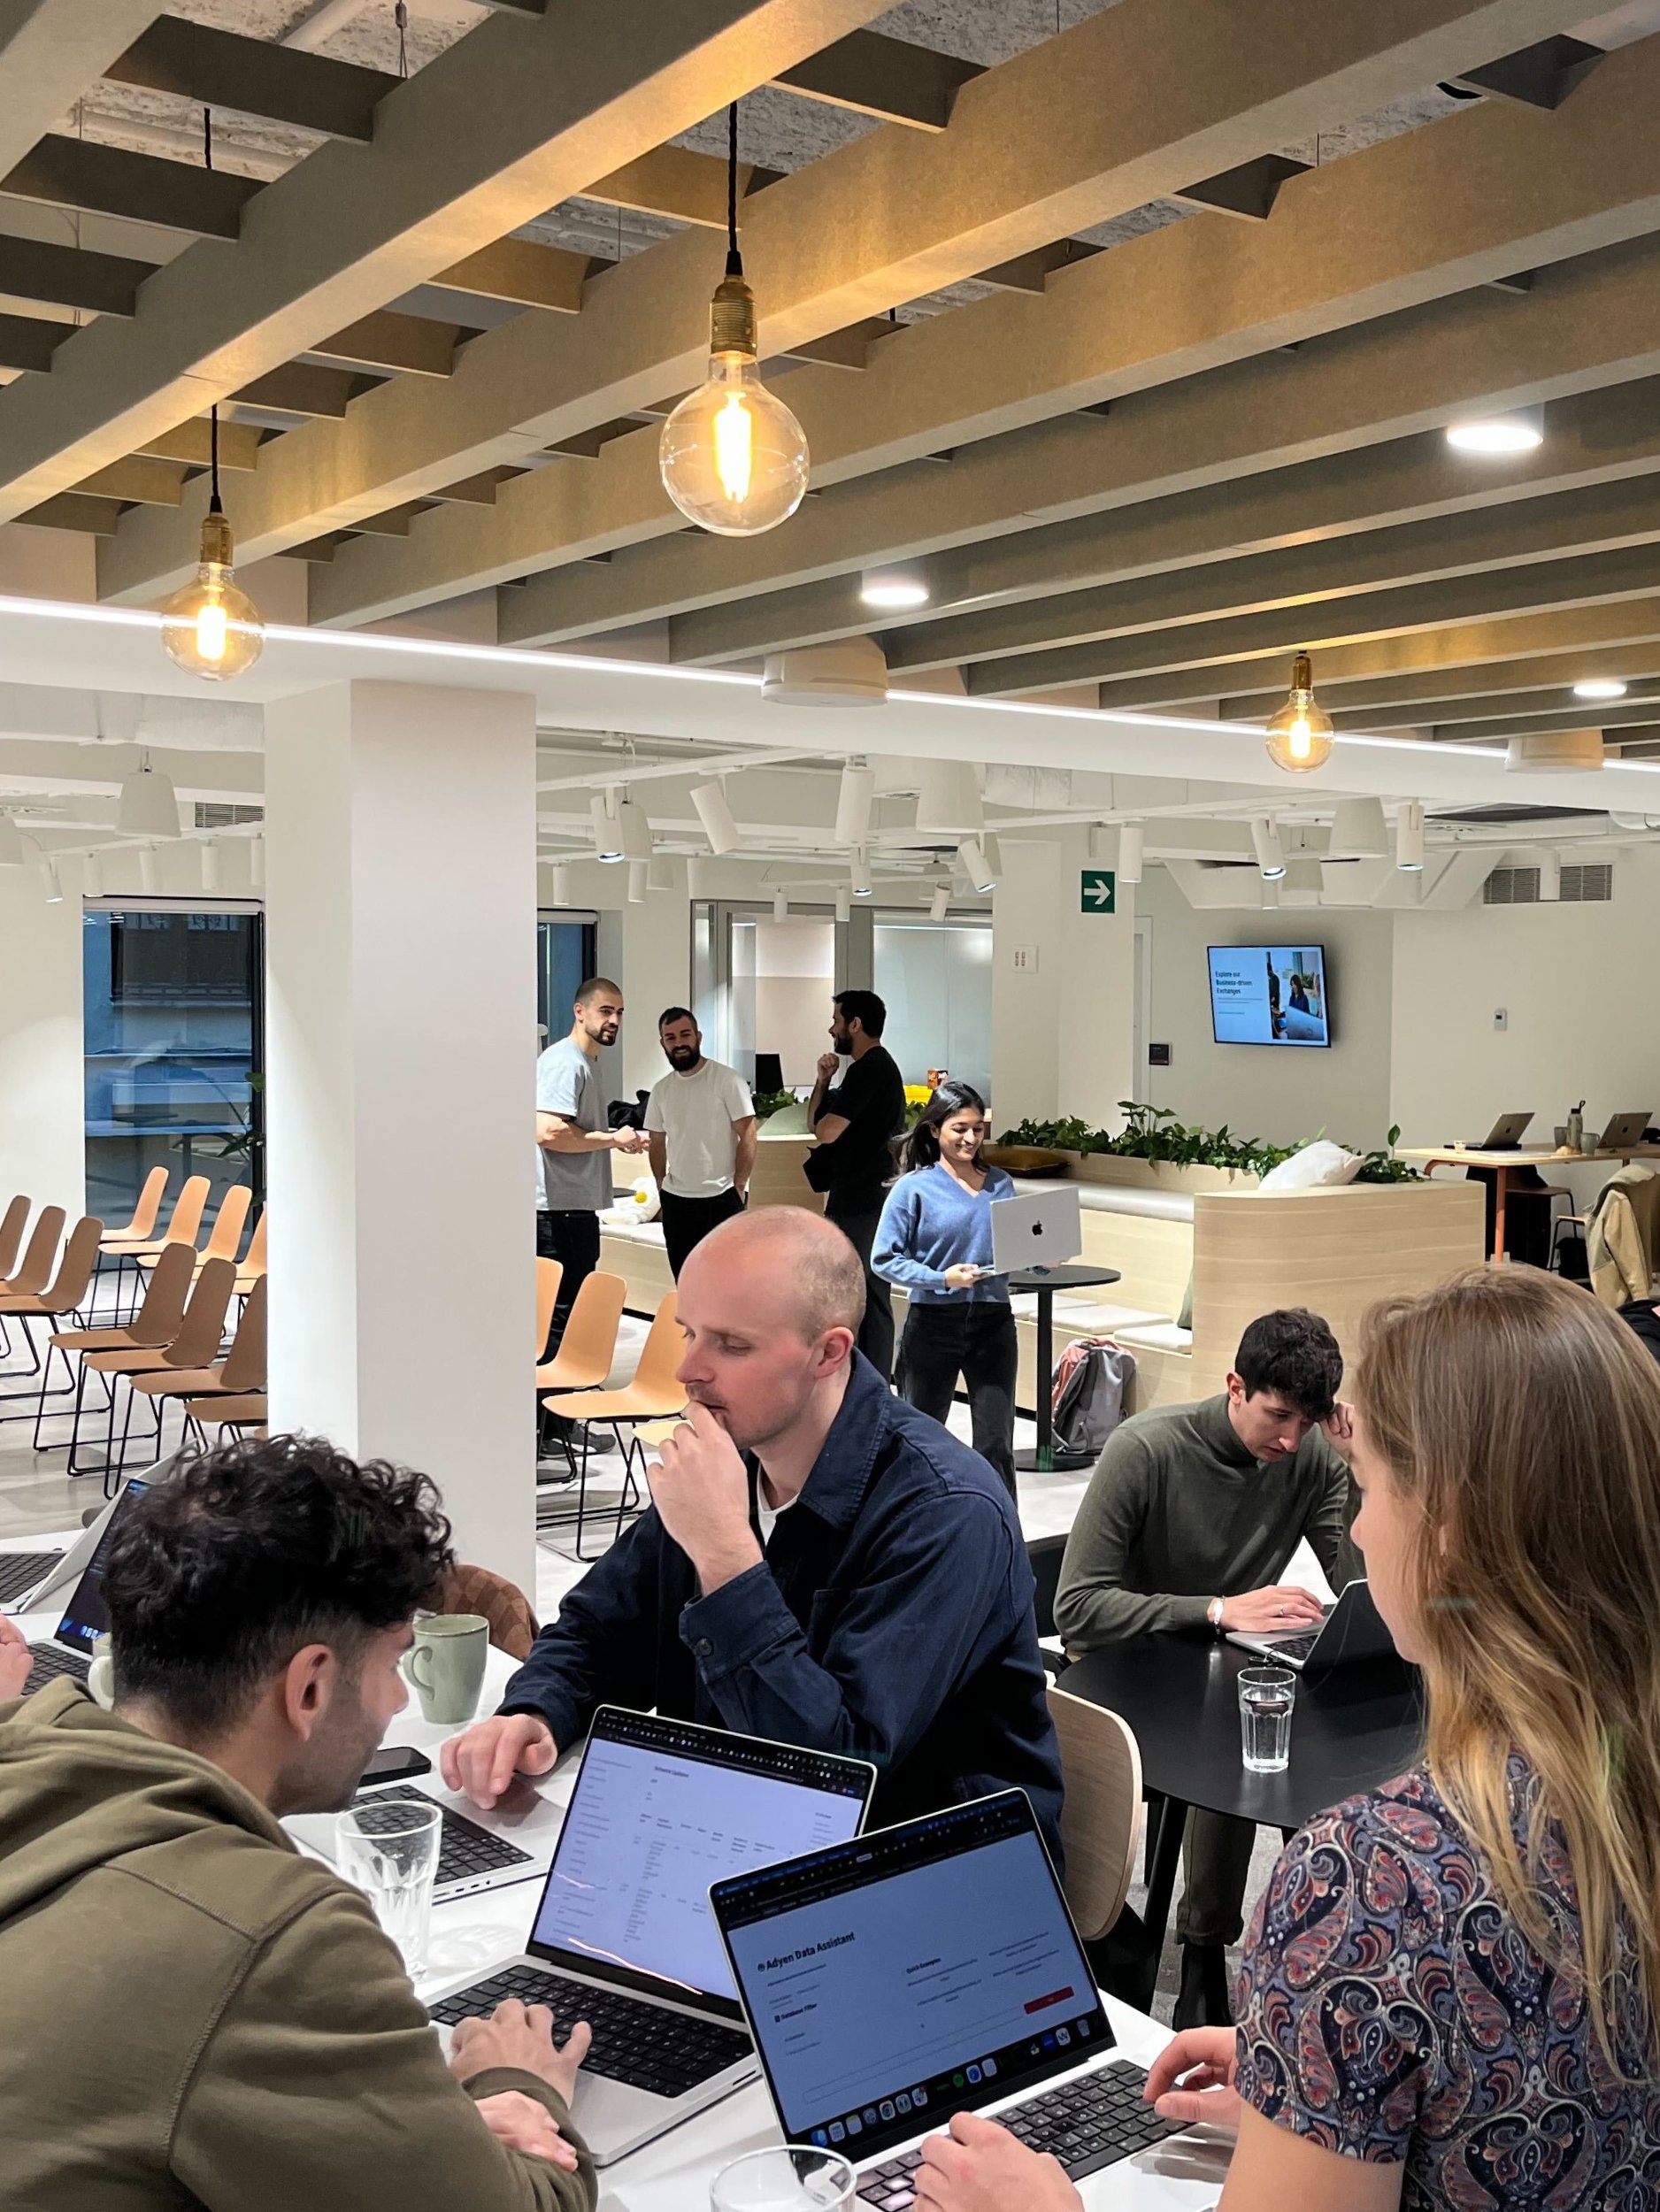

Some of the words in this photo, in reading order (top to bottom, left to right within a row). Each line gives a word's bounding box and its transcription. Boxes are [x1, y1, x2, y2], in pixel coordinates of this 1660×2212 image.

[766, 1954, 795, 1970] Adyen
[795, 1946, 816, 1960] Data
[817, 1932, 856, 1953] Assistant
